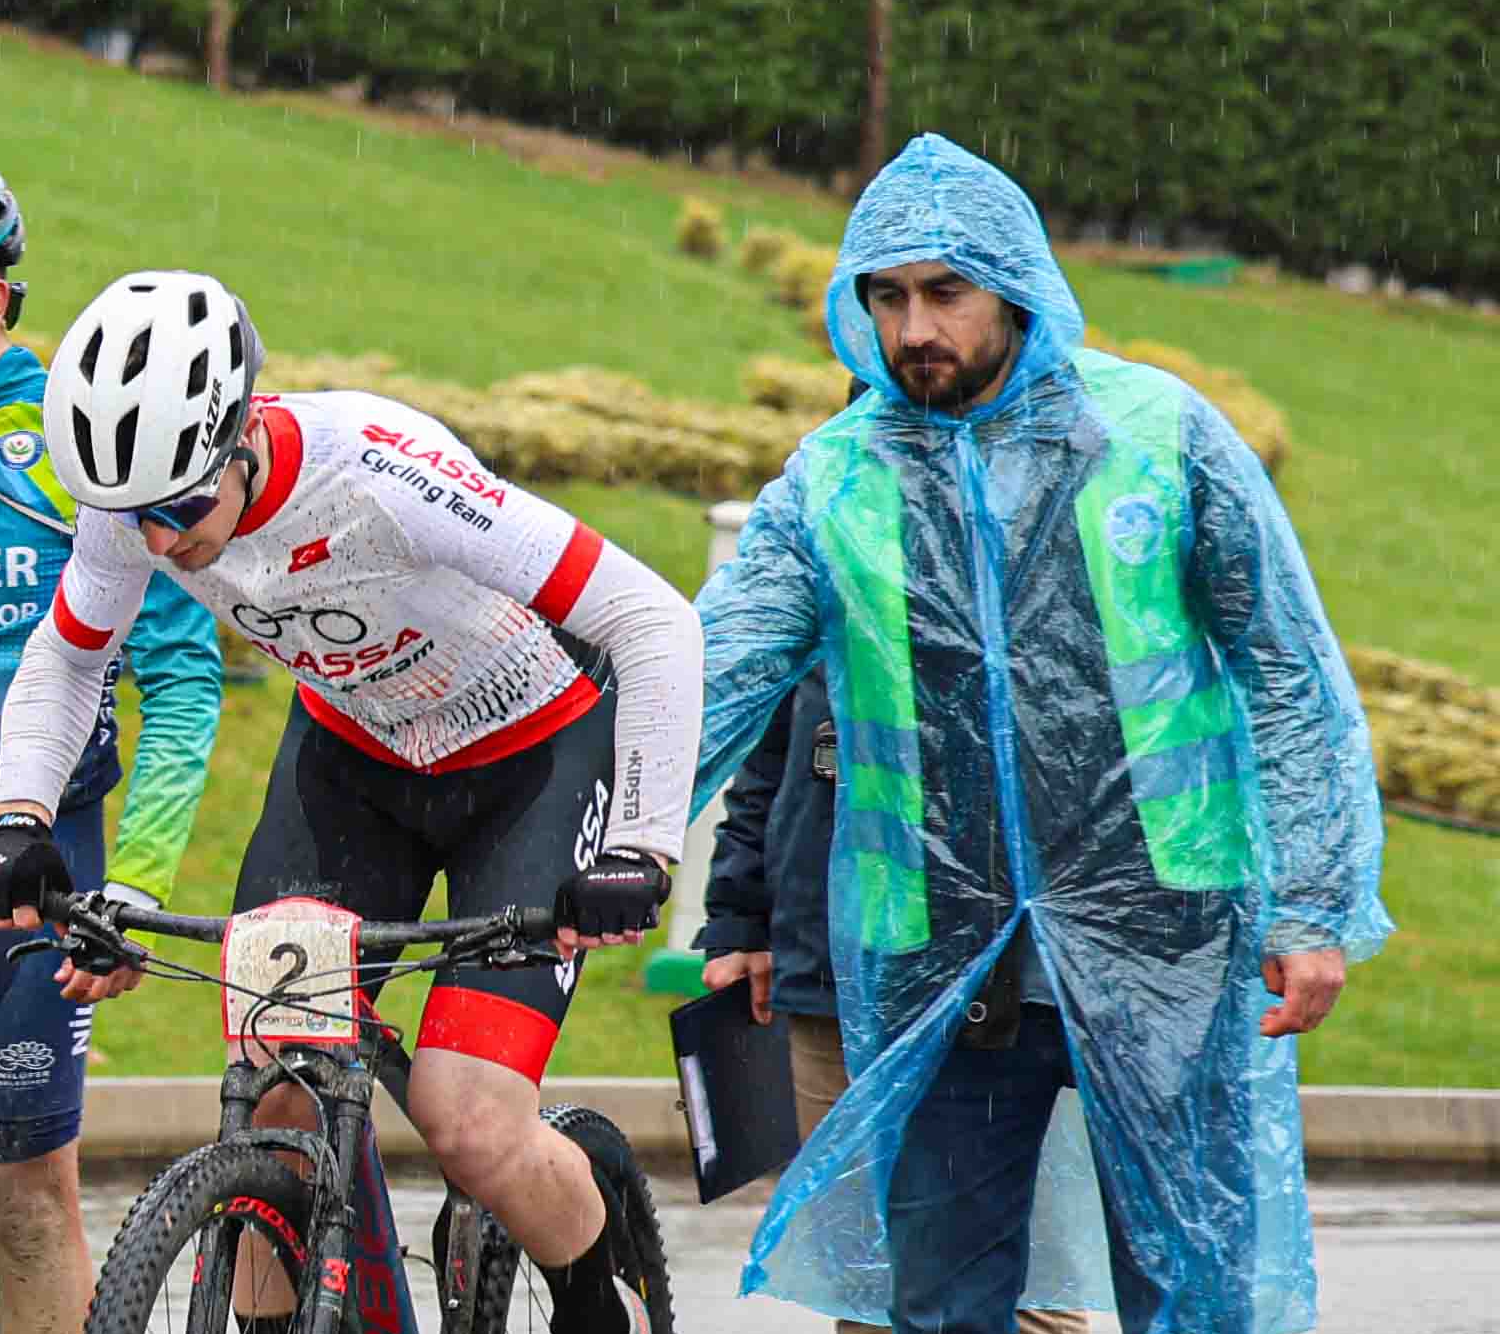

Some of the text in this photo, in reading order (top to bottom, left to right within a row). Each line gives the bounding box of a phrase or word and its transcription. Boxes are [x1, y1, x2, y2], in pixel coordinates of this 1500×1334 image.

[201, 378, 221, 451] LAZER
[361, 449, 493, 532] Cycling Team
[574, 779, 609, 872] SSA
[269, 943, 310, 1002] 2
